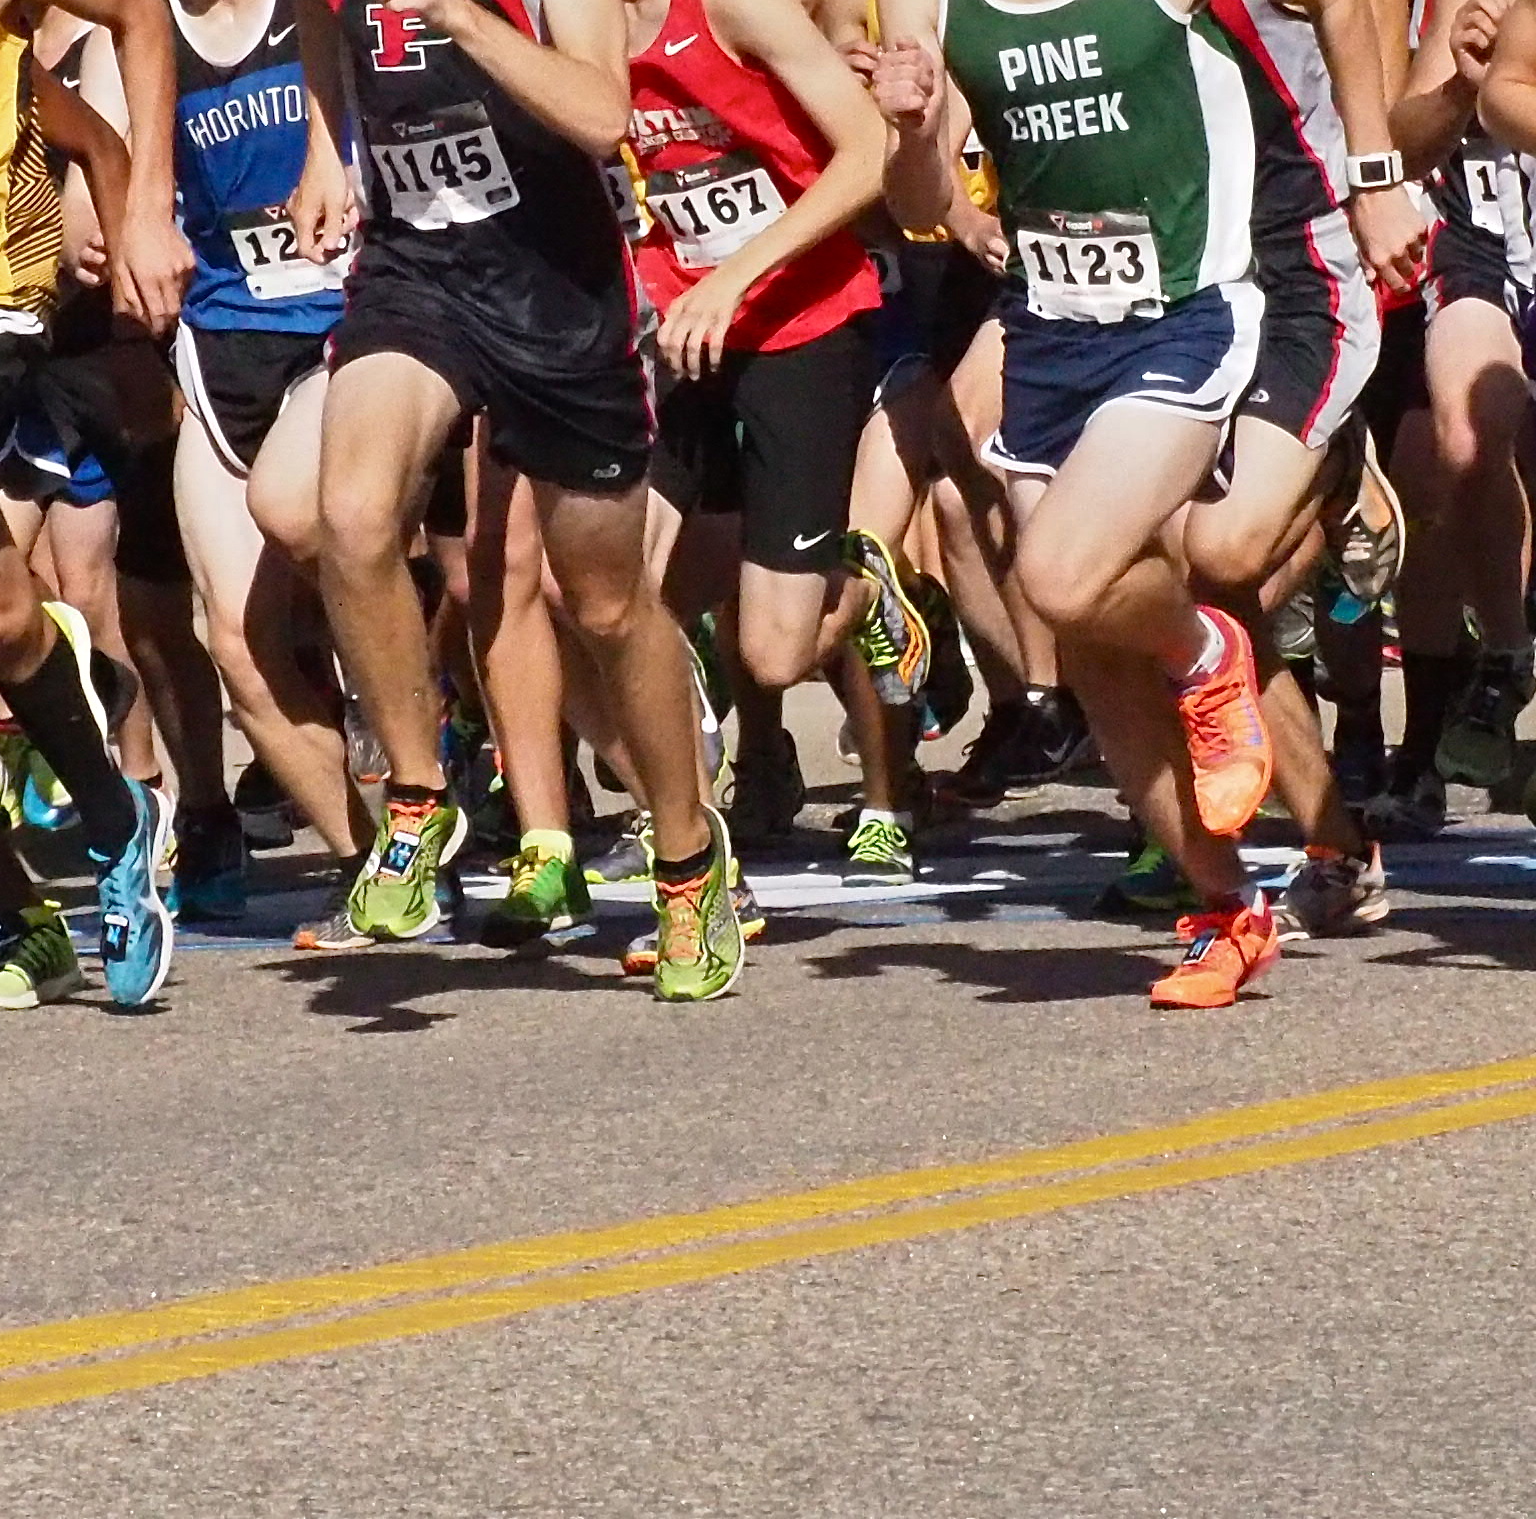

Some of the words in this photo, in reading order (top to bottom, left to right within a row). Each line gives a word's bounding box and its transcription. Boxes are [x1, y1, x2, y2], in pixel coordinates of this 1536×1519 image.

[998, 34, 1103, 92] PINE
[184, 84, 309, 150] THORNTO
[1003, 92, 1130, 142] CREEK
[381, 135, 492, 193] 1145
[659, 176, 768, 237] 1167
[1028, 239, 1145, 286] 1123
